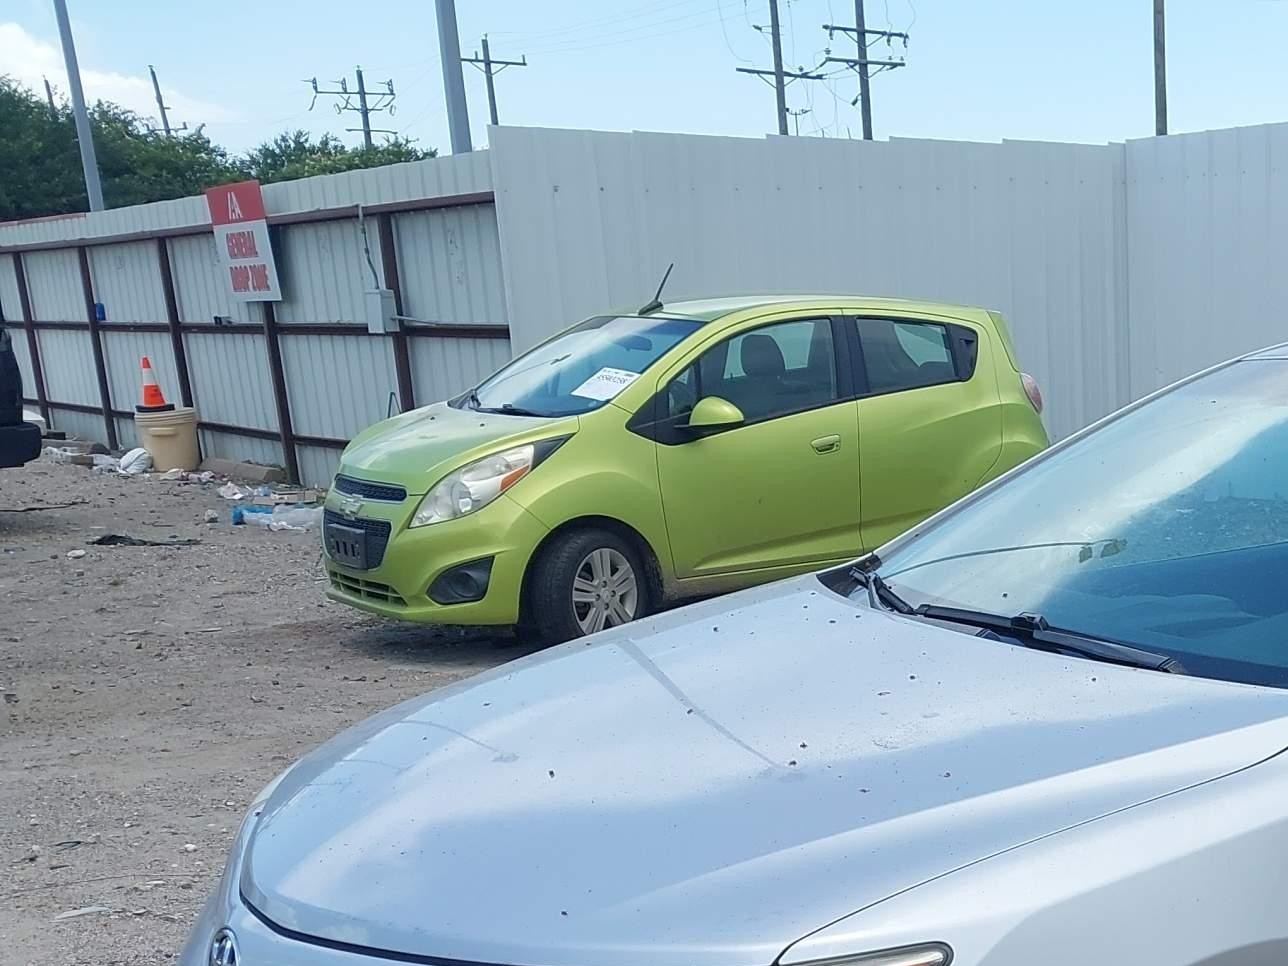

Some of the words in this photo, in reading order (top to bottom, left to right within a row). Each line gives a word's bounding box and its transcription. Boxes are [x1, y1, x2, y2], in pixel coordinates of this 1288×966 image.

[226, 231, 259, 259] GENERAL
[230, 264, 251, 292] DROP
[249, 264, 272, 292] ZONE
